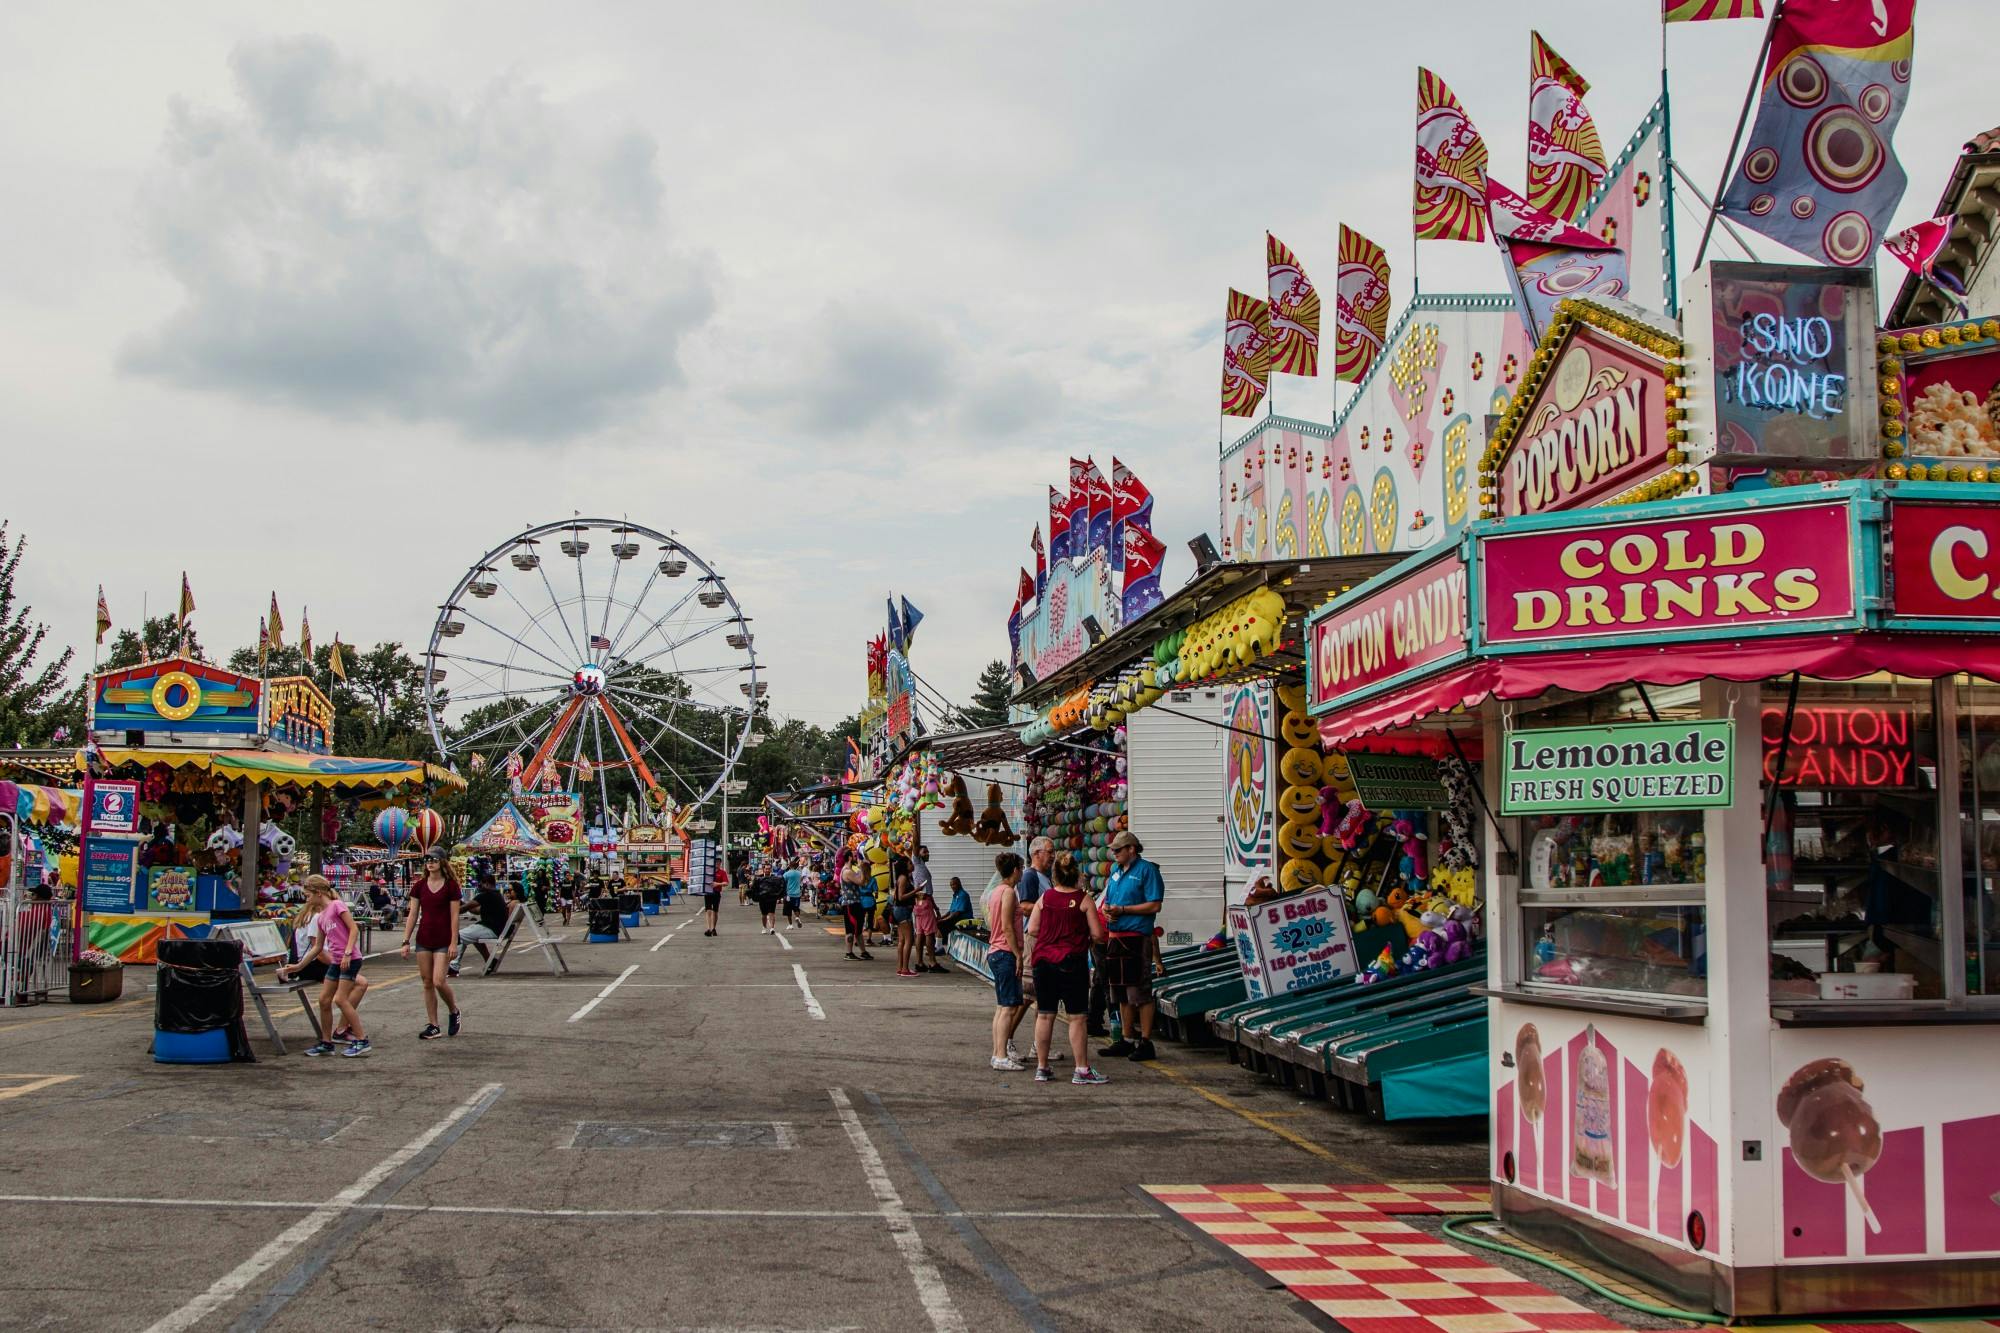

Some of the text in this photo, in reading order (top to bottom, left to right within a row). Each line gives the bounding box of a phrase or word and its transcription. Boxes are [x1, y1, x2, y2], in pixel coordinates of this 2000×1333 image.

[1754, 313, 1832, 358] SNO
[1737, 361, 1845, 414] KONE
[1511, 378, 1646, 516] POPCORN
[1560, 523, 1765, 579] COLD
[1512, 567, 1820, 632] DRINKS
[1321, 568, 1465, 689] COTTON CANDY
[1761, 708, 1908, 745] COTTON
[1511, 730, 1727, 771] Lemonade
[1763, 747, 1911, 785] CANDY
[1350, 757, 1441, 782] Lemonade
[108, 794, 121, 811] 2
[1361, 786, 1394, 801] FRESH
[1509, 773, 1725, 804] FRESH SQUEEZED
[1268, 908, 1280, 924] 5
[1284, 898, 1328, 920] Balls
[1282, 922, 1323, 948] $2.00
[1270, 954, 1297, 971] 150
[1298, 955, 1308, 963] or
[1308, 943, 1346, 962] higher
[1292, 960, 1331, 978] WINS
